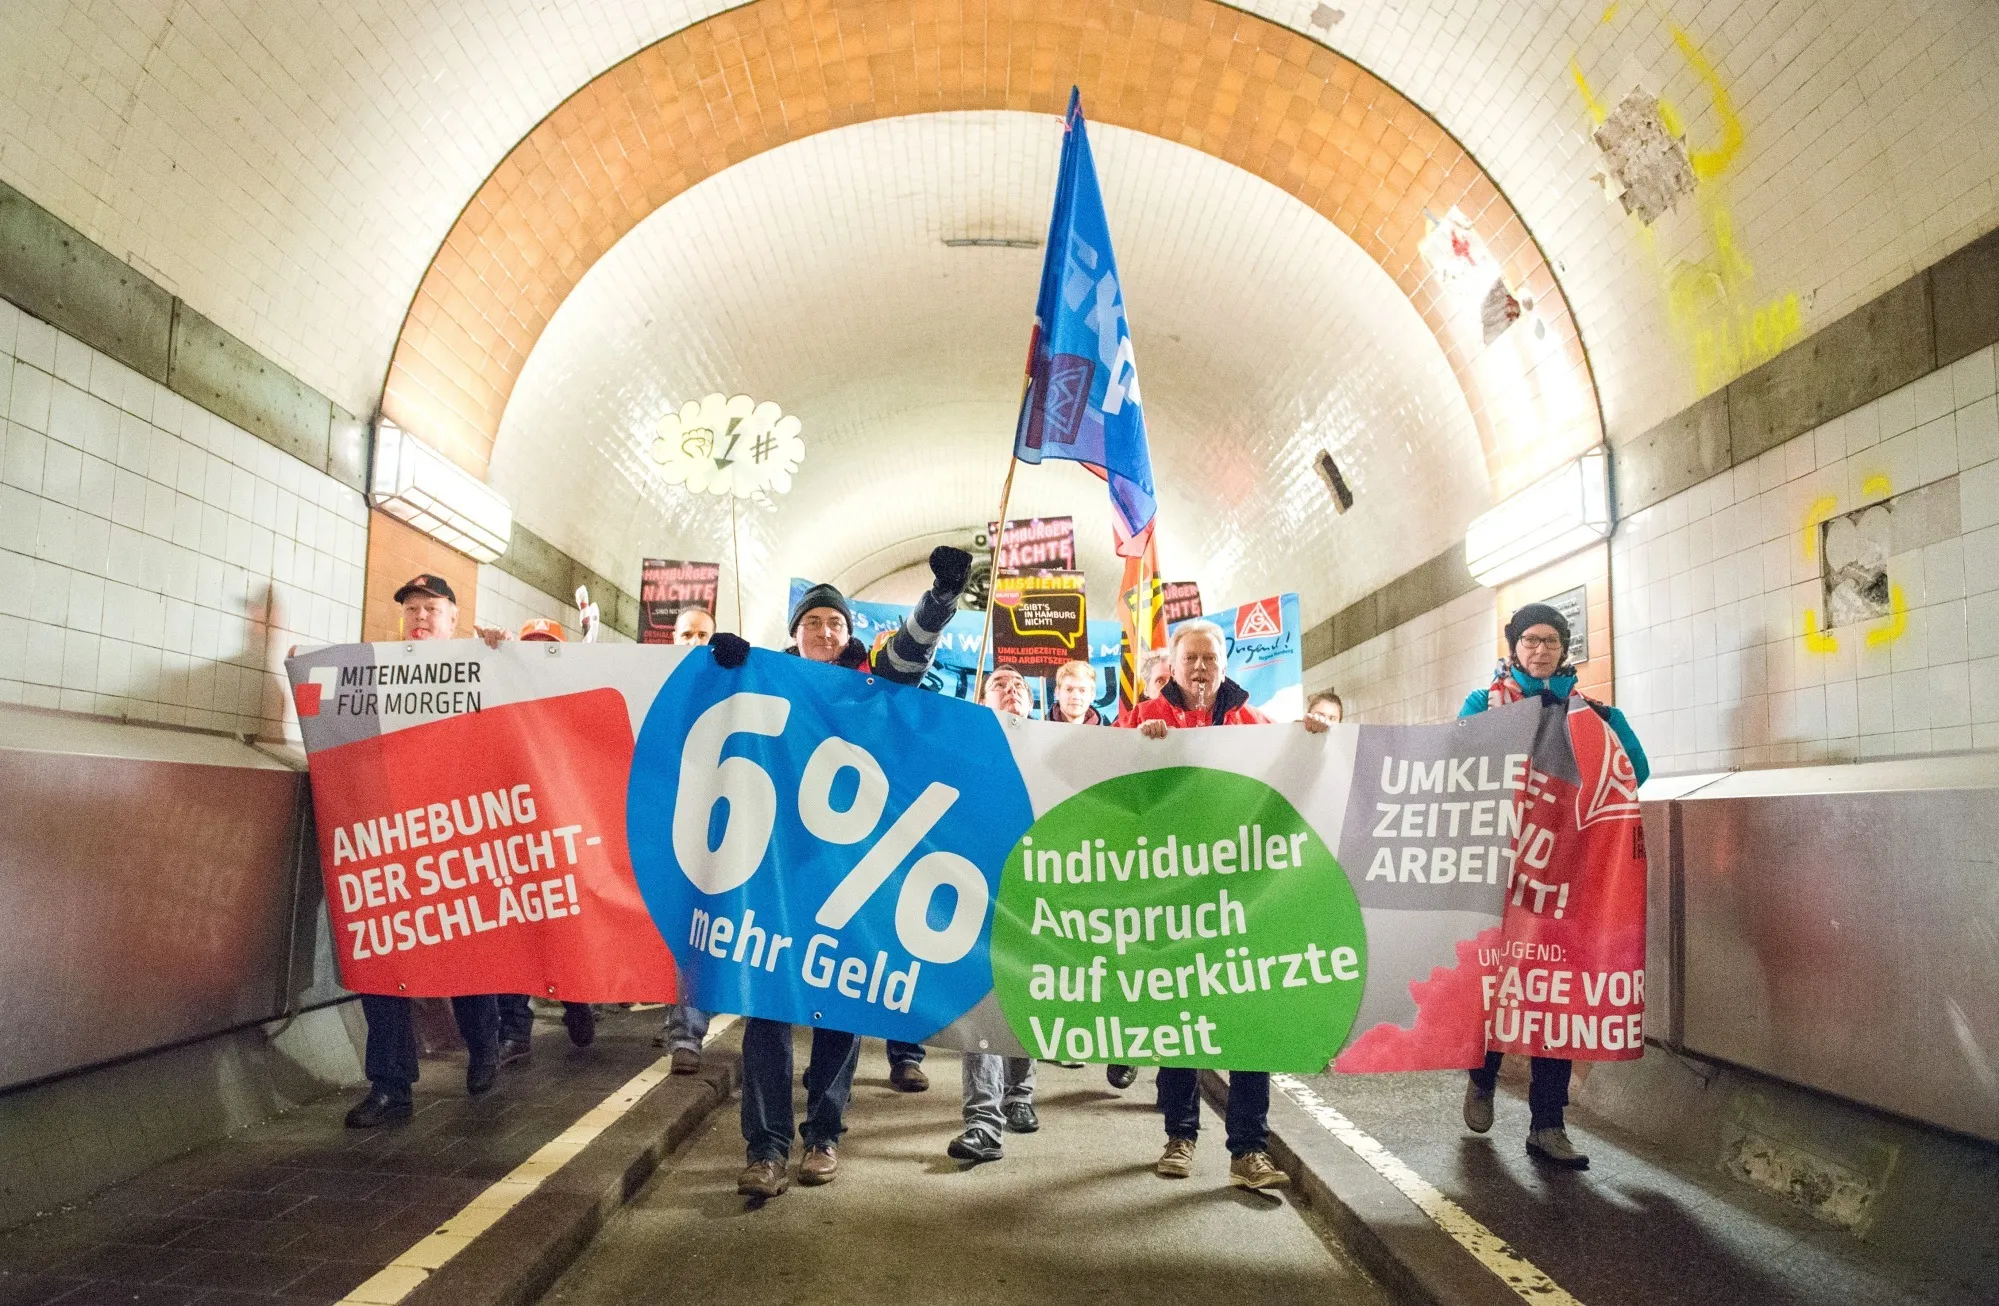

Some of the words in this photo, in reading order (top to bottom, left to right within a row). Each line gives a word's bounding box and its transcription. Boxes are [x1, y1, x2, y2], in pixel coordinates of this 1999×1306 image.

[1035, 611, 1076, 619] HAMBURG
[1164, 585, 1198, 600] URGER
[1025, 618, 1053, 626] NICHT!
[341, 662, 481, 686] MITEINANDER
[998, 647, 1068, 656] UMKLEIDEZEITEN
[998, 655, 1017, 663] SIND
[337, 690, 378, 716] FÜR
[384, 691, 481, 715] MORGEN
[333, 784, 536, 866] ANHEBUNG
[672, 692, 989, 963] 6%
[1372, 800, 1525, 840] ZEITEN
[339, 864, 407, 914] DER
[416, 825, 601, 895] SCHICHT-
[1023, 824, 1307, 884] individueller
[347, 875, 581, 960] ZUSCHLÄGE!
[1031, 889, 1246, 955] Anspruch
[689, 907, 793, 972] mehr
[801, 934, 921, 1013] Geld
[1029, 956, 1107, 1002] auf
[1117, 943, 1359, 1003] verkürzte
[1030, 1012, 1221, 1060] Vollzeit
